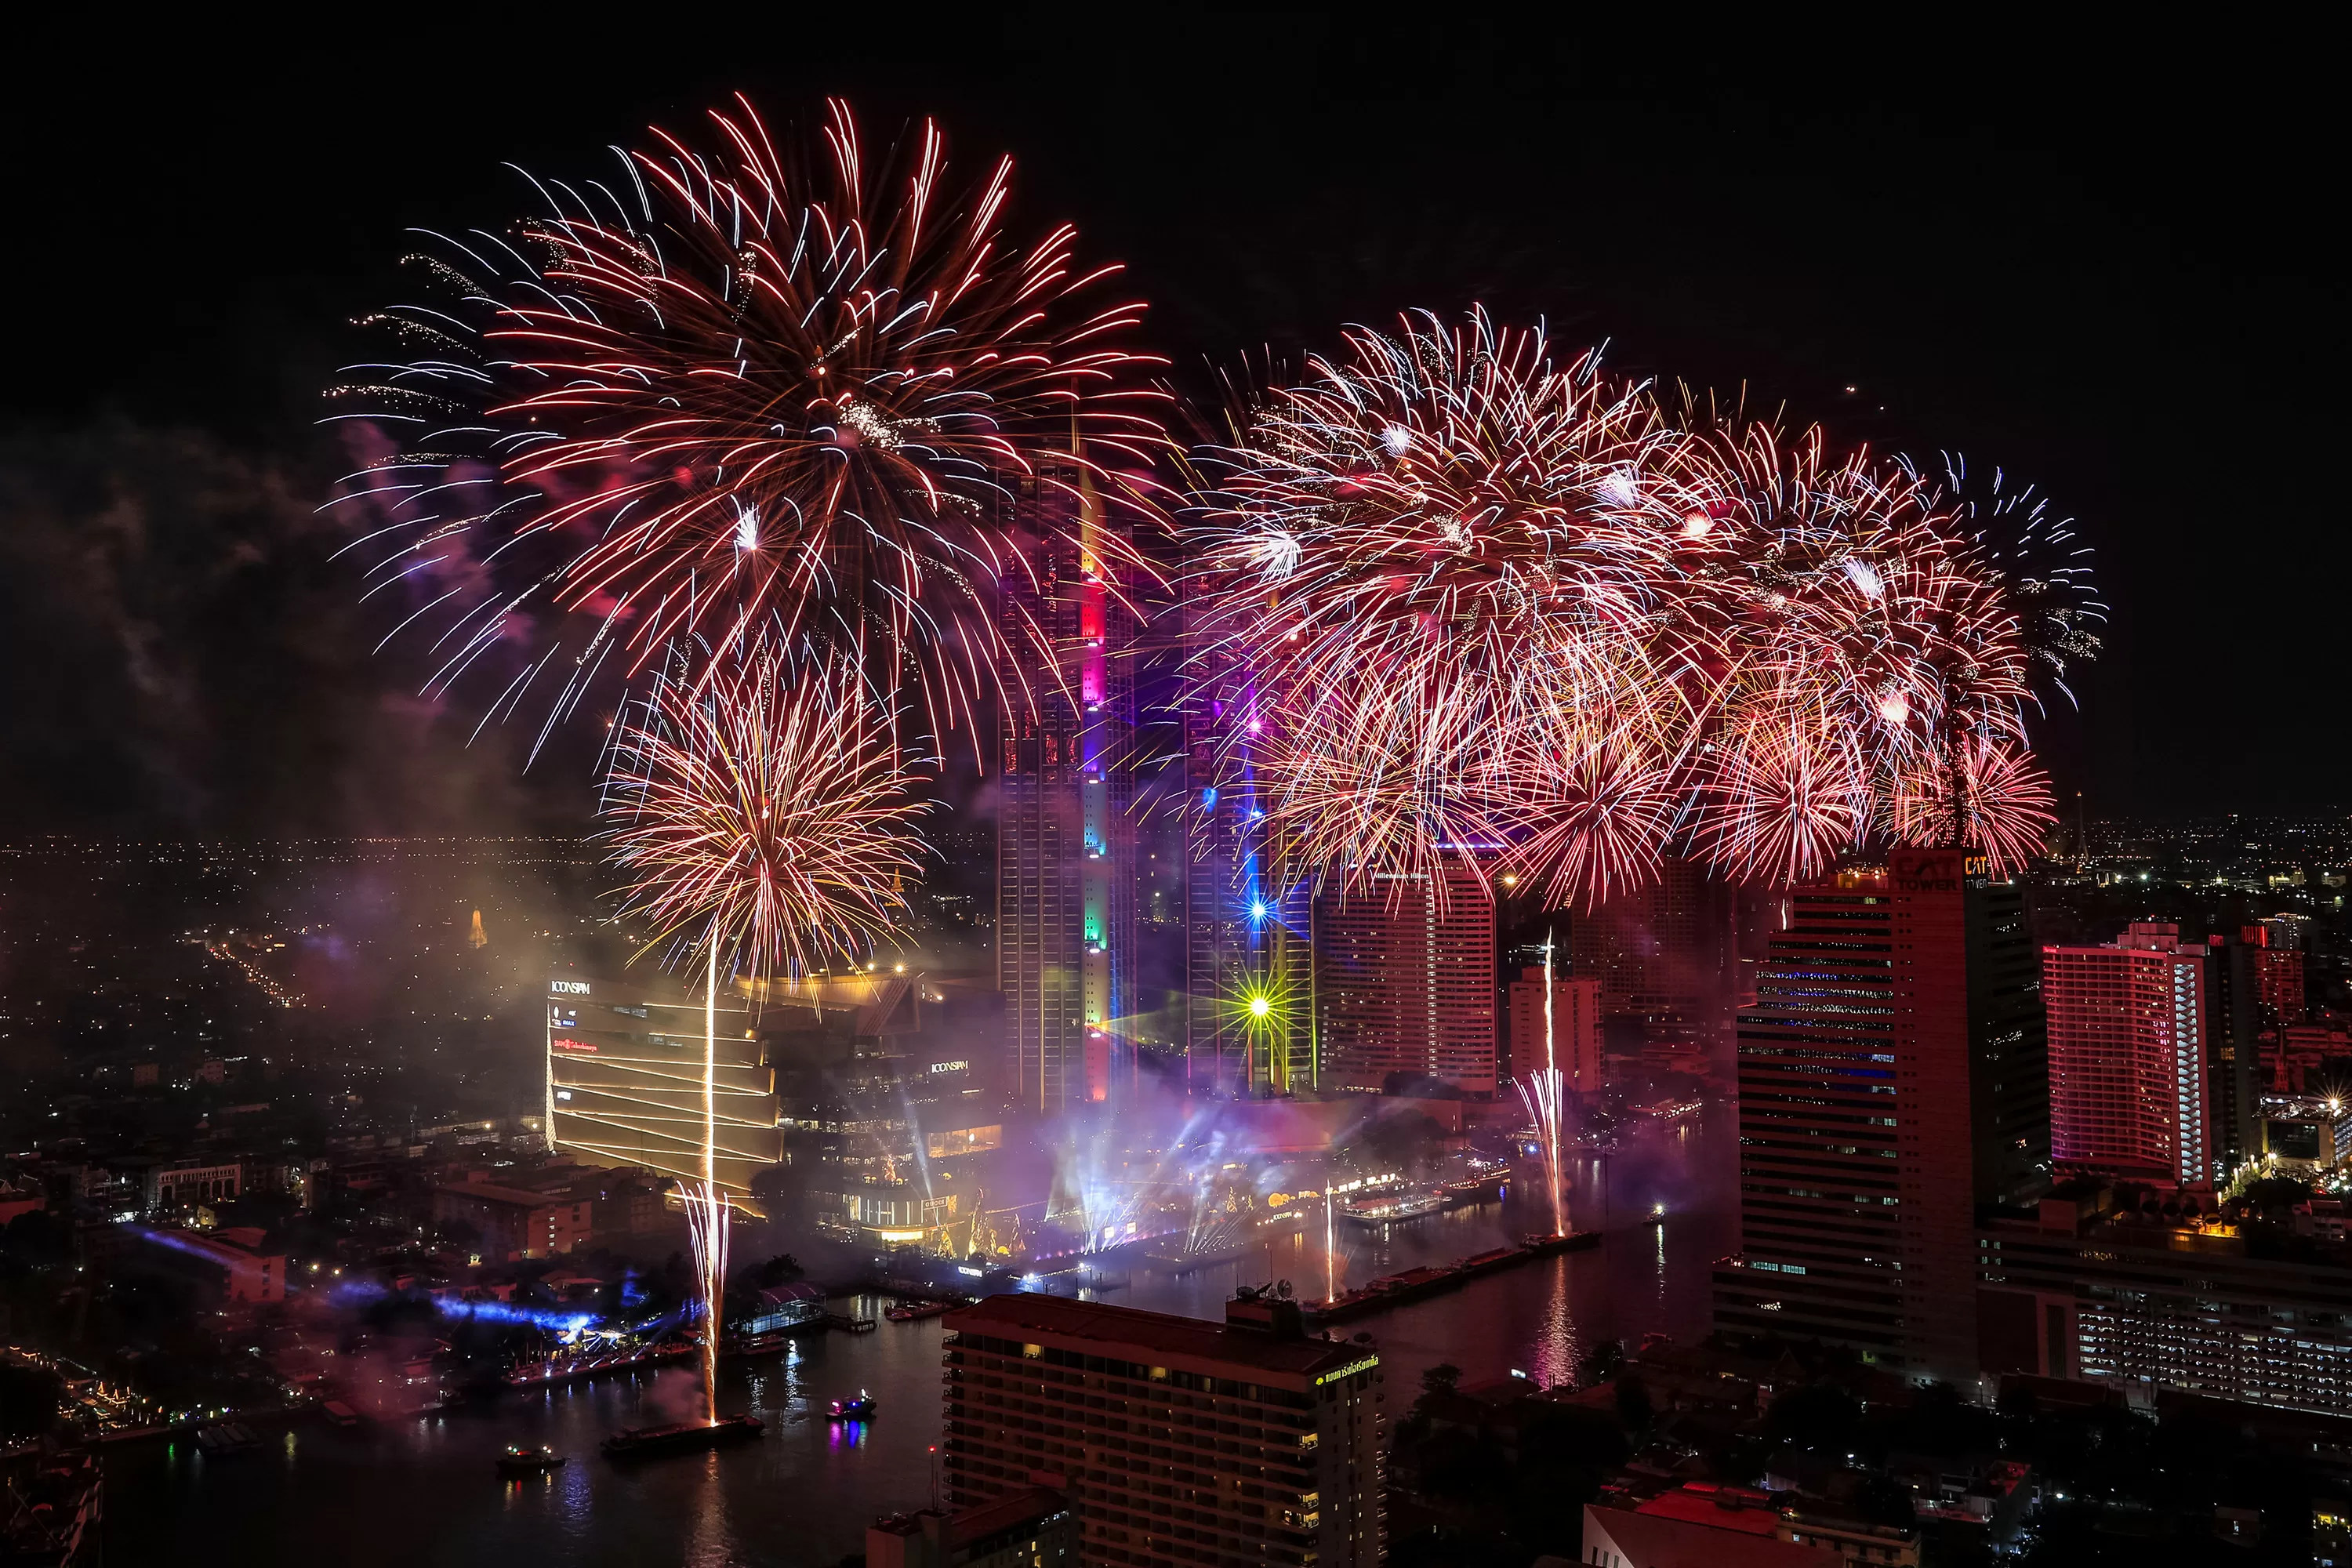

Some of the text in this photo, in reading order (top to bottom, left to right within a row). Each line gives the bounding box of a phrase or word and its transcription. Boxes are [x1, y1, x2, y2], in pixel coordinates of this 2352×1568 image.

[1896, 857, 1957, 876] CAT
[1965, 856, 1987, 874] CAT
[1897, 879, 1957, 891] TOWER
[552, 981, 590, 994] ICONSIAM
[931, 1060, 968, 1073] ICONSIAM
[925, 1199, 944, 1207] GUCCI
